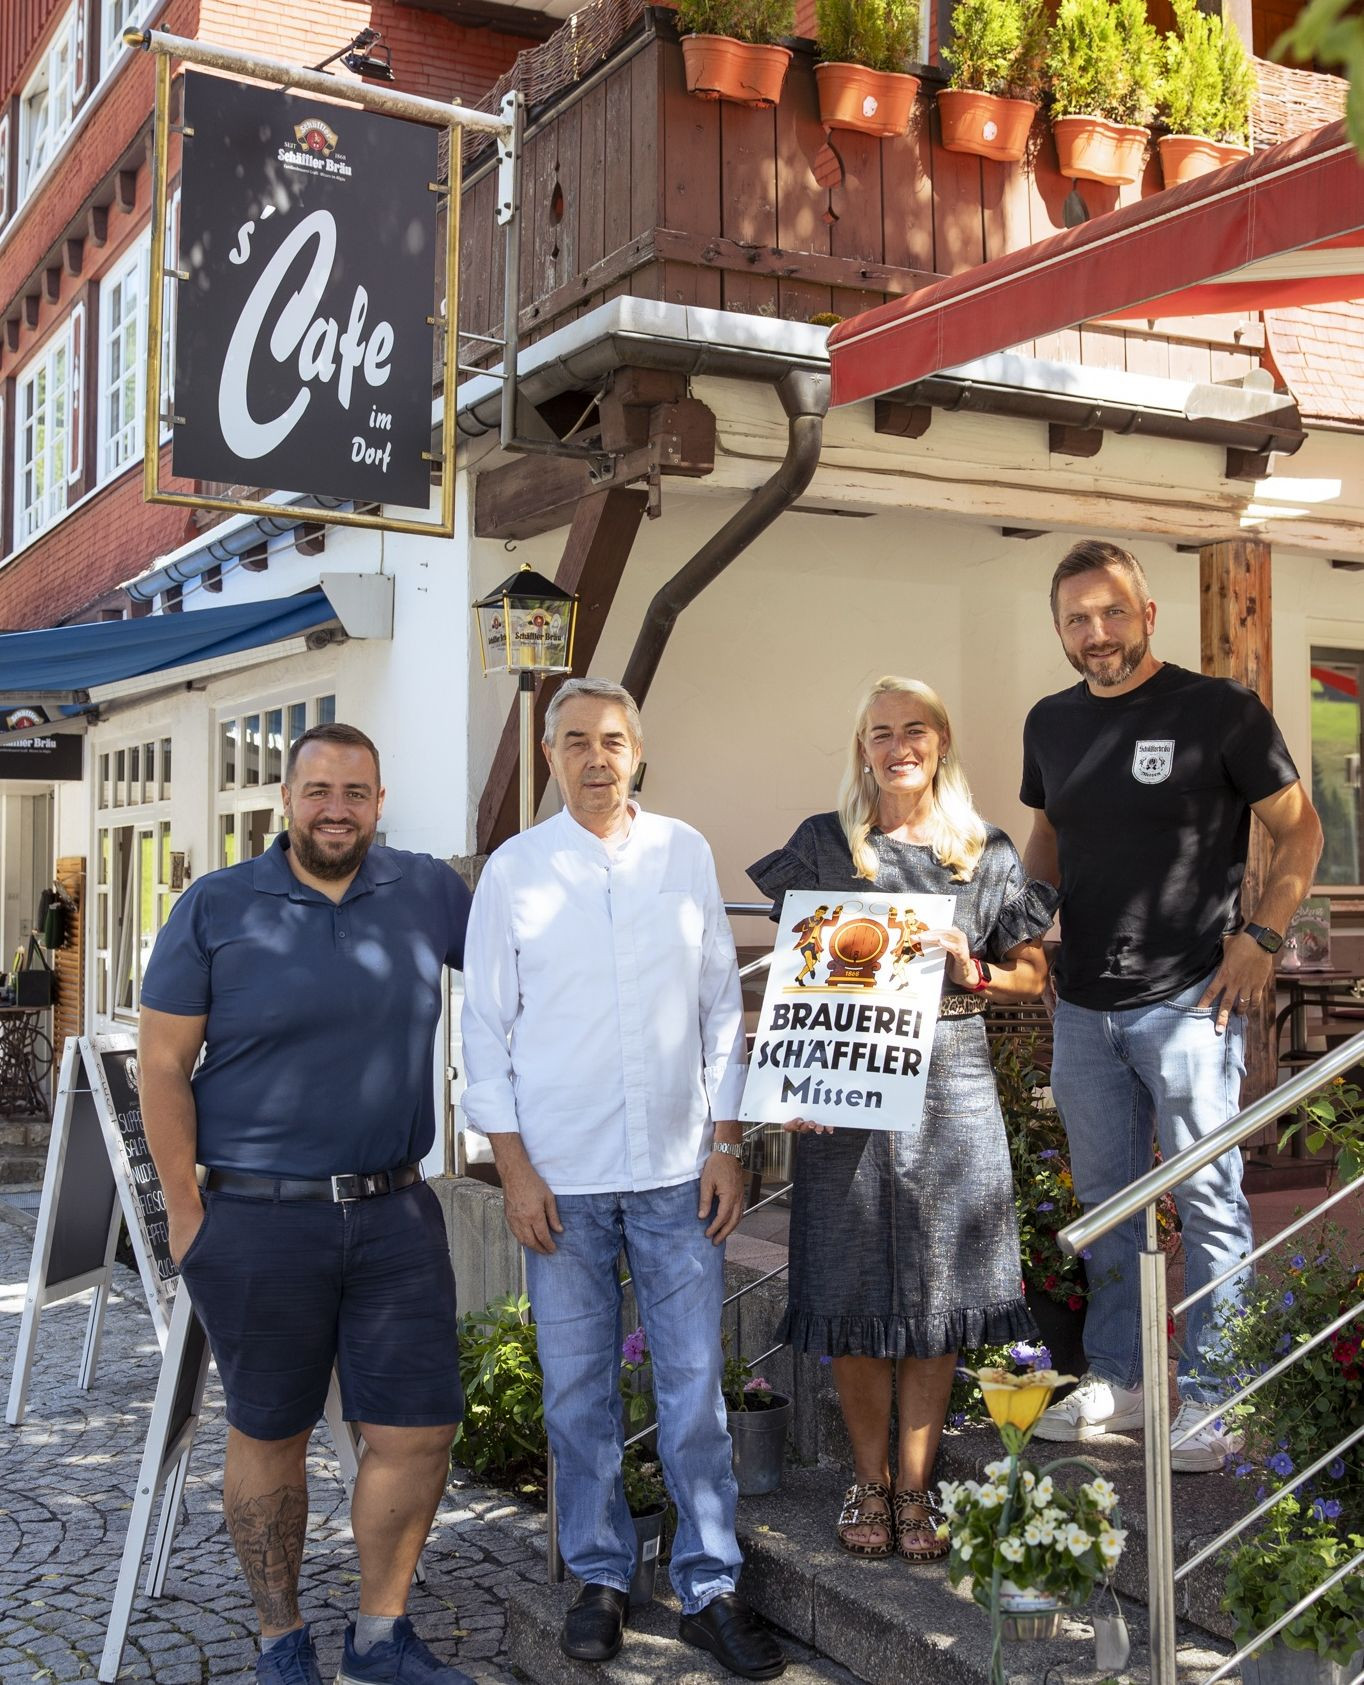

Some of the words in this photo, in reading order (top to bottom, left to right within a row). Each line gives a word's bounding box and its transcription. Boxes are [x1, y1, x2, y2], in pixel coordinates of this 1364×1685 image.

[278, 148, 325, 170] Schäffler
[325, 158, 352, 176] Bräu
[218, 210, 394, 459] Cafe
[369, 405, 392, 431] im
[351, 436, 392, 473] Dorf
[33, 737, 56, 748] Bräu
[769, 1002, 923, 1039] BRAUEREI
[757, 1039, 922, 1078] SCHÄFFLER
[780, 1074, 883, 1108] Missen
